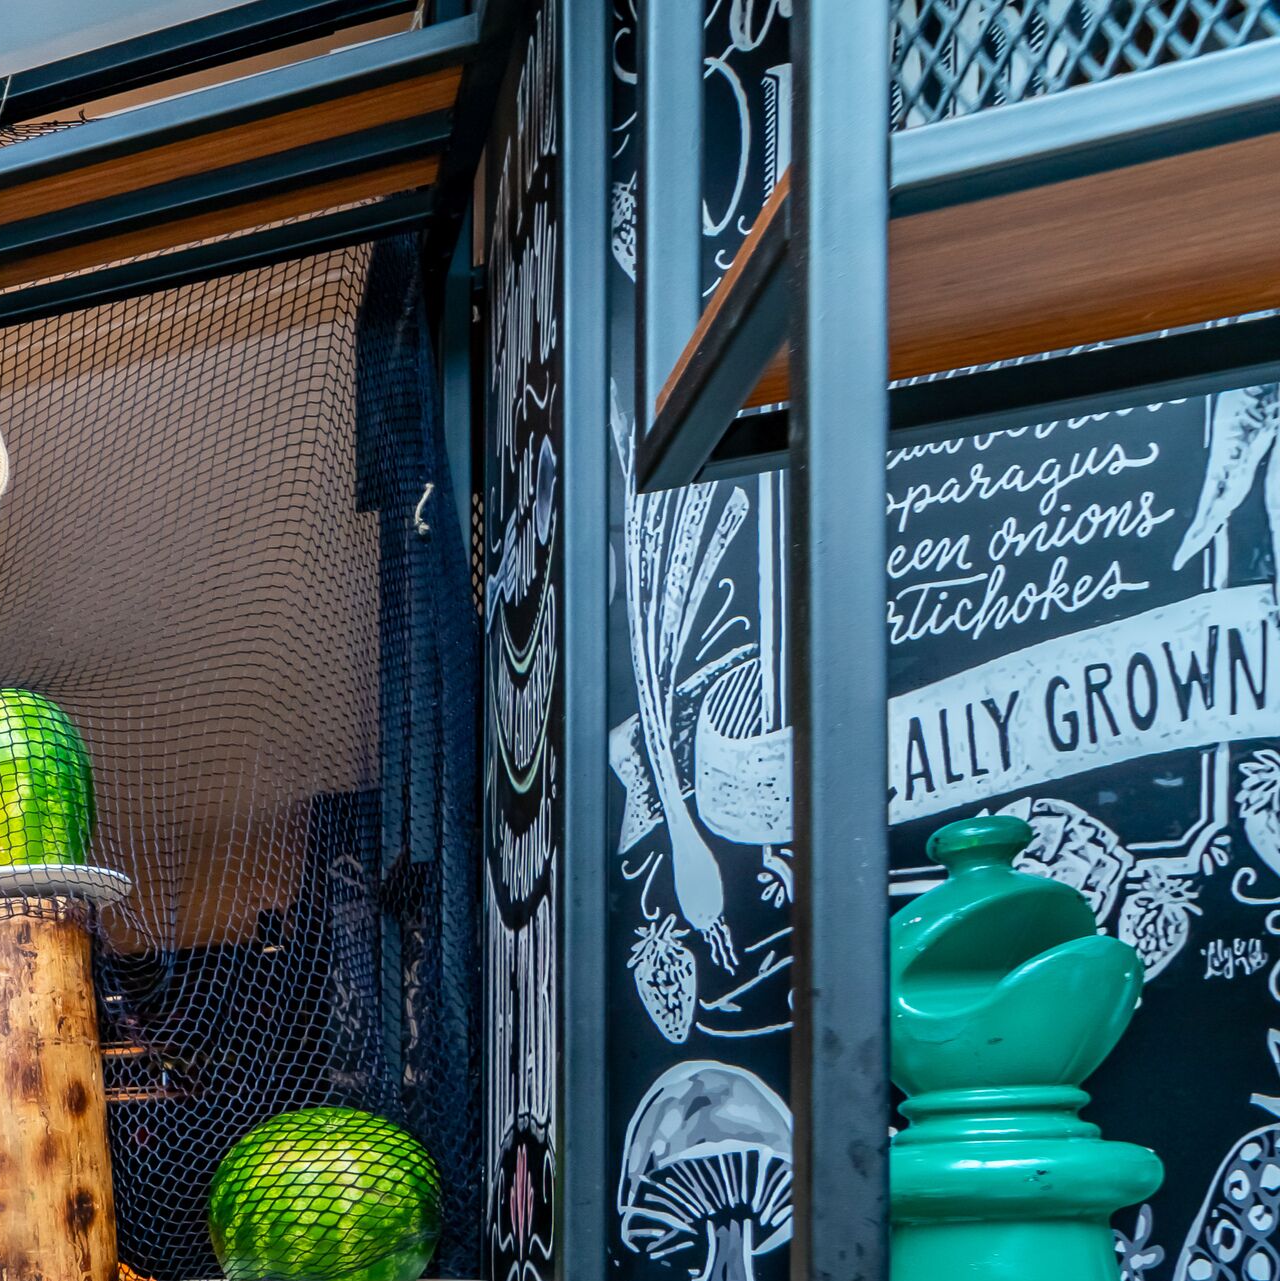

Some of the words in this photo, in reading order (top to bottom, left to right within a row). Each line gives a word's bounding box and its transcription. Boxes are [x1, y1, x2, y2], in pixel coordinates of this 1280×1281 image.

[886, 442, 1160, 533] paragus
[989, 491, 1175, 561] onions
[886, 556, 1150, 645] rtichokes
[905, 690, 1020, 801] ALLY
[1045, 619, 1269, 752] GROWN
